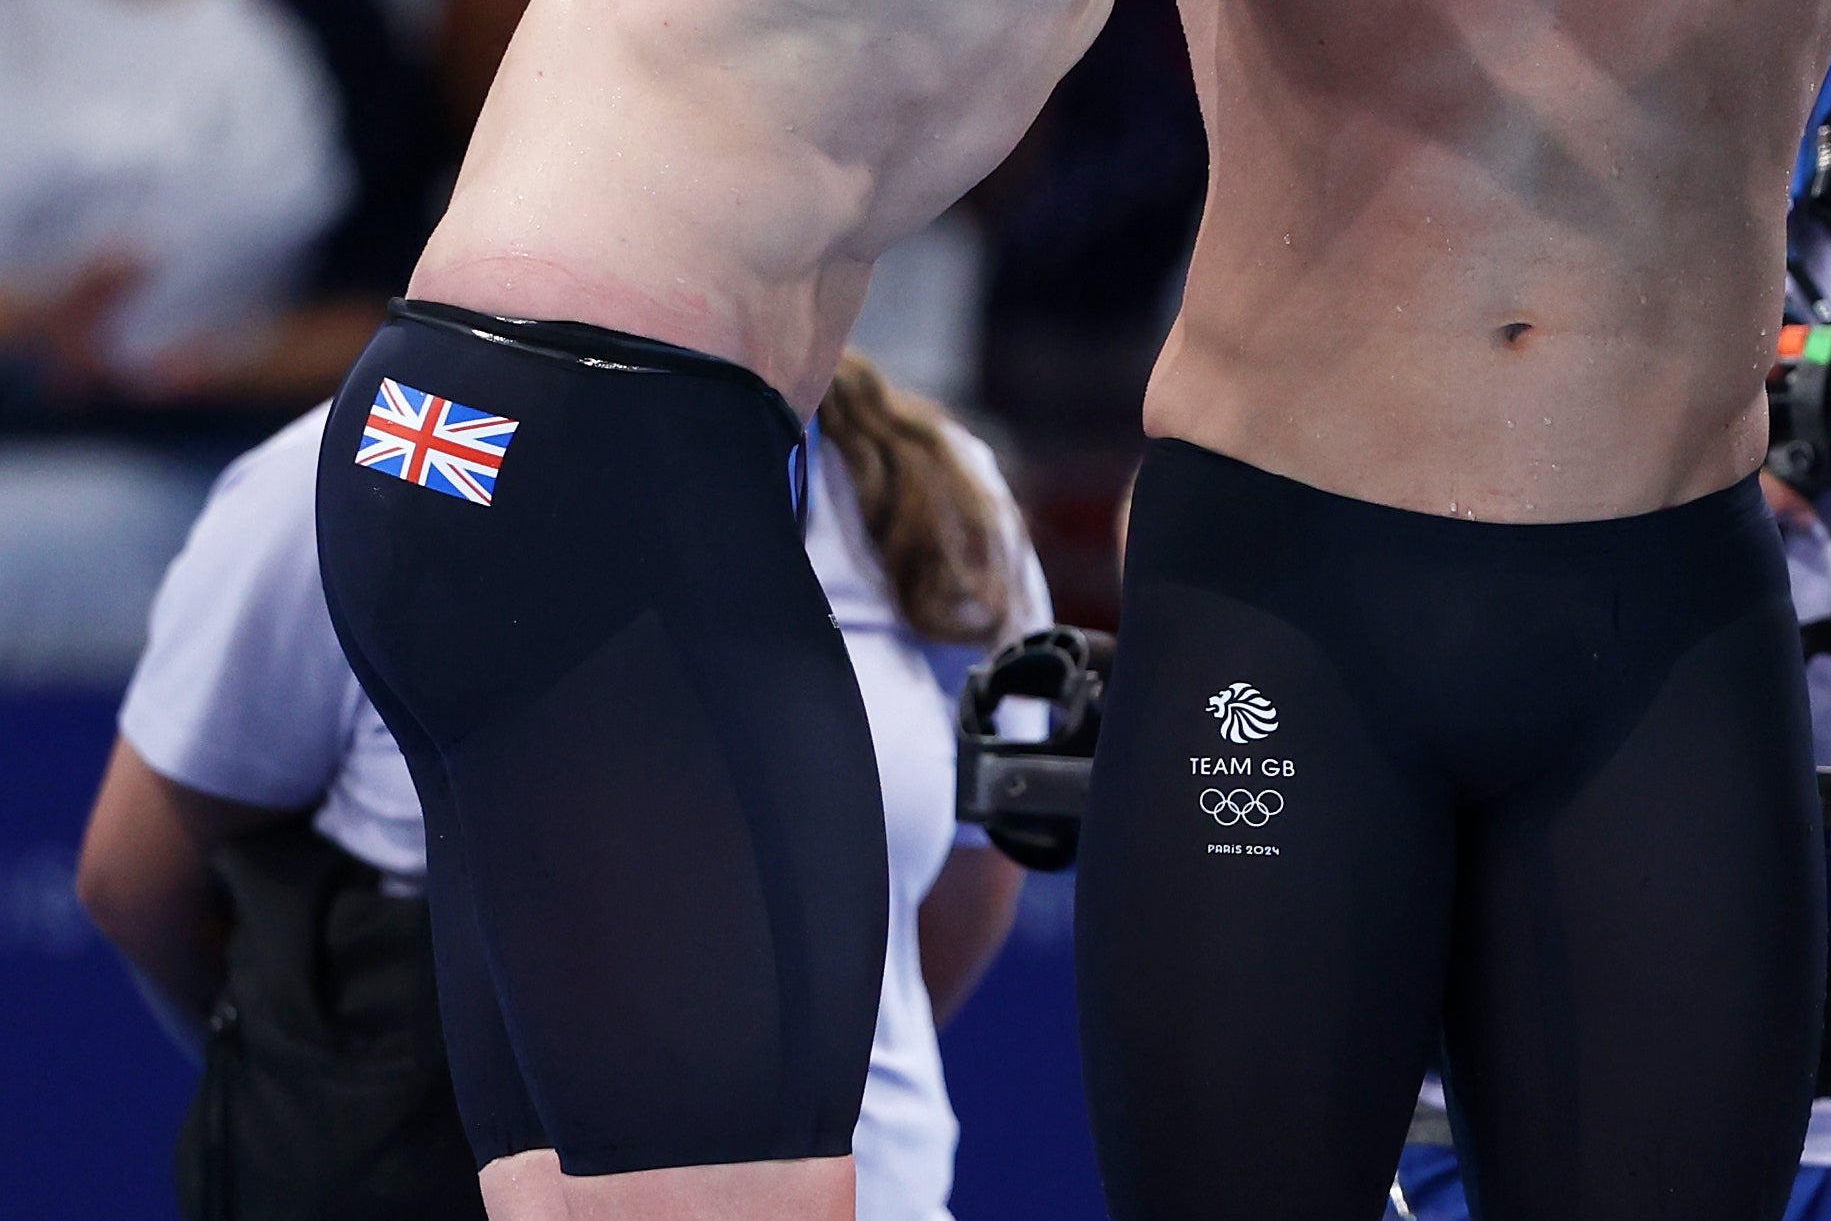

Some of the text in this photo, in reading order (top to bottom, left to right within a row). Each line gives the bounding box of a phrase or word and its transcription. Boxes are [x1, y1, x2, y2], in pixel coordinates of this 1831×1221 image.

[1189, 757, 1296, 777] TEAM GB
[1245, 845, 1280, 856] 2024
